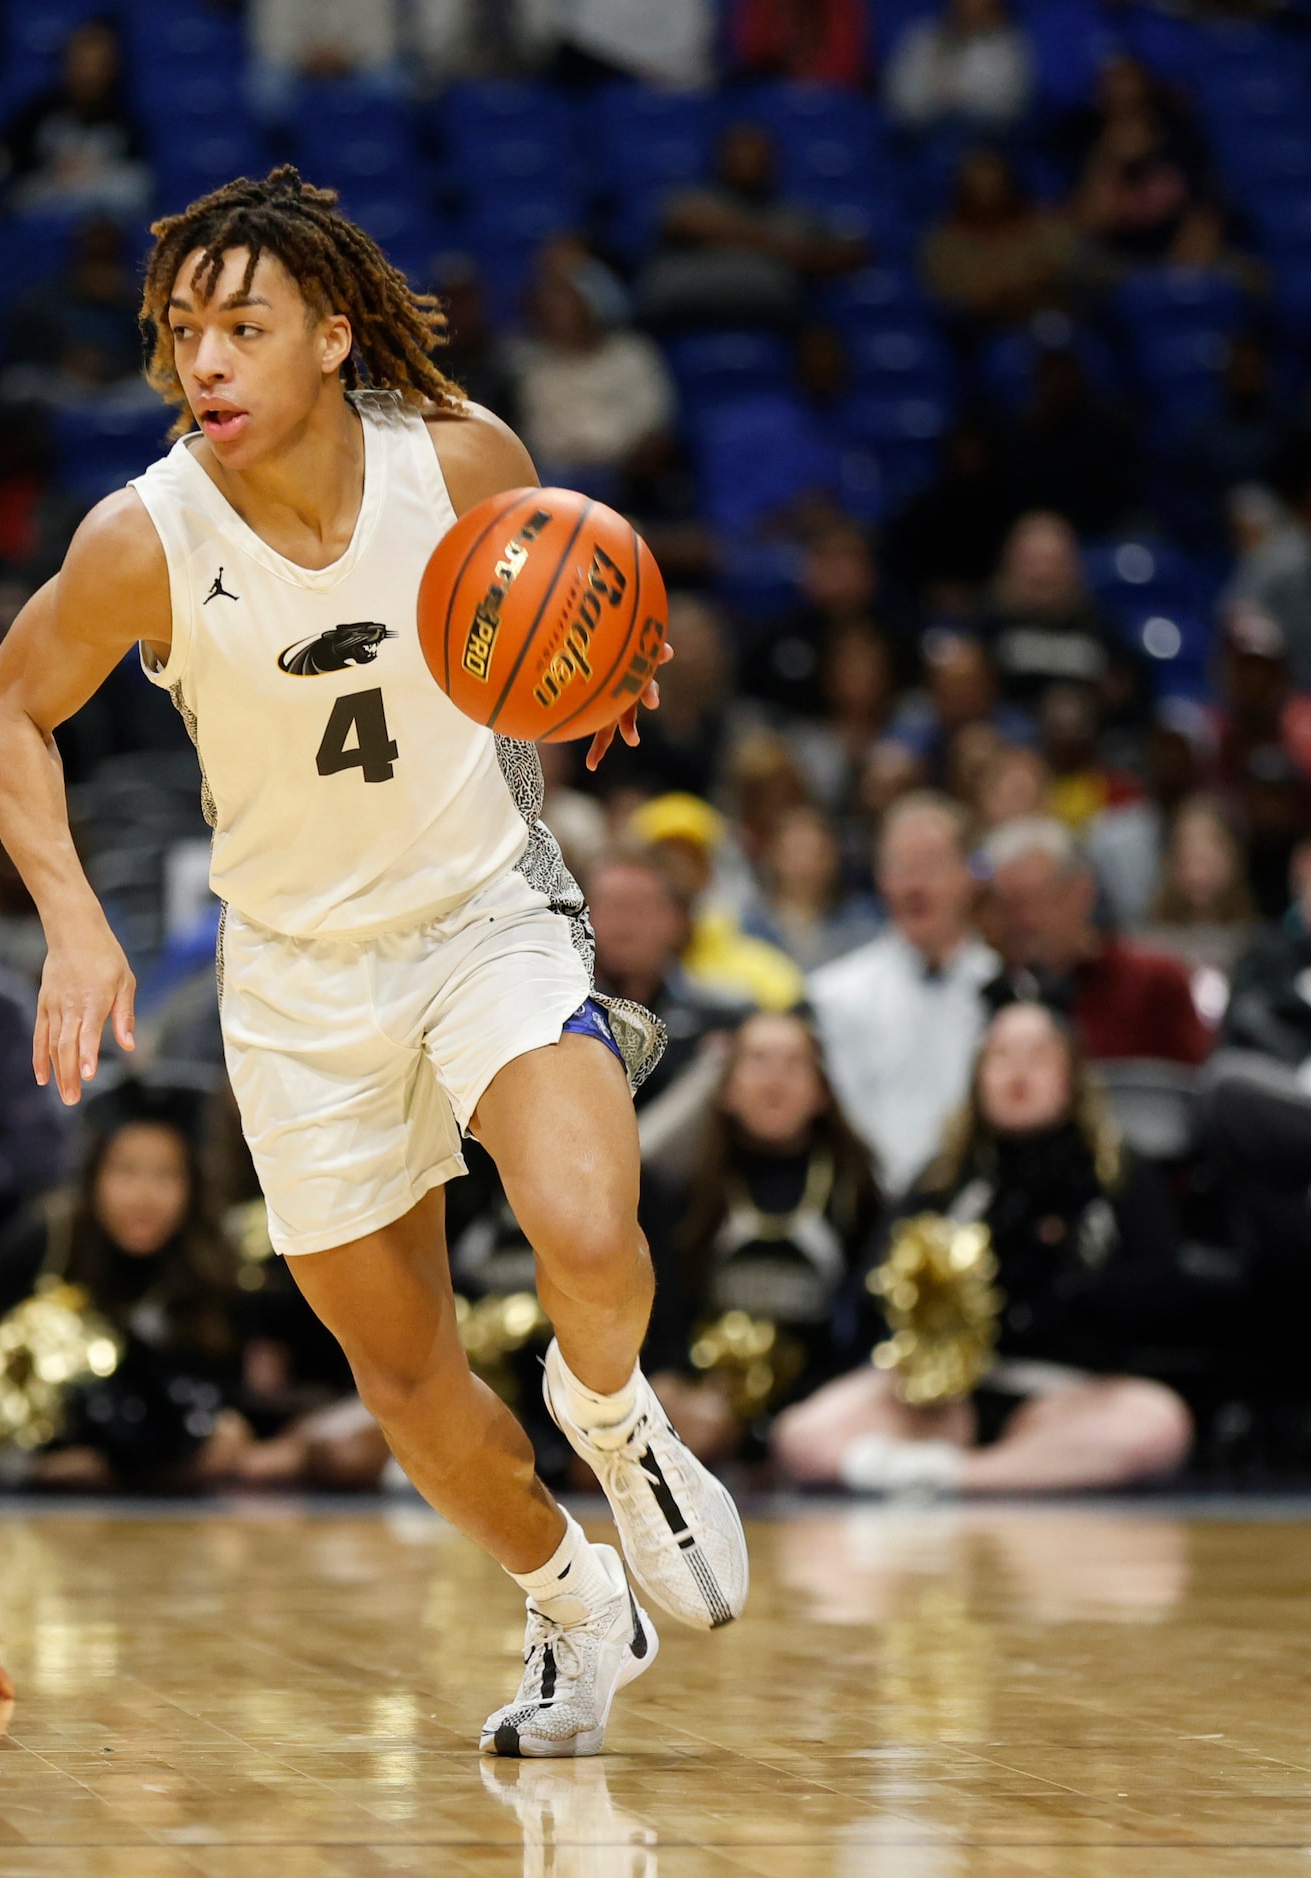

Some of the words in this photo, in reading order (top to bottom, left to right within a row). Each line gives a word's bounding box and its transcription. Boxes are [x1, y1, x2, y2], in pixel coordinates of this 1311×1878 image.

[464, 619, 499, 679] PRO
[533, 543, 627, 708] Baden
[315, 687, 399, 783] 4
